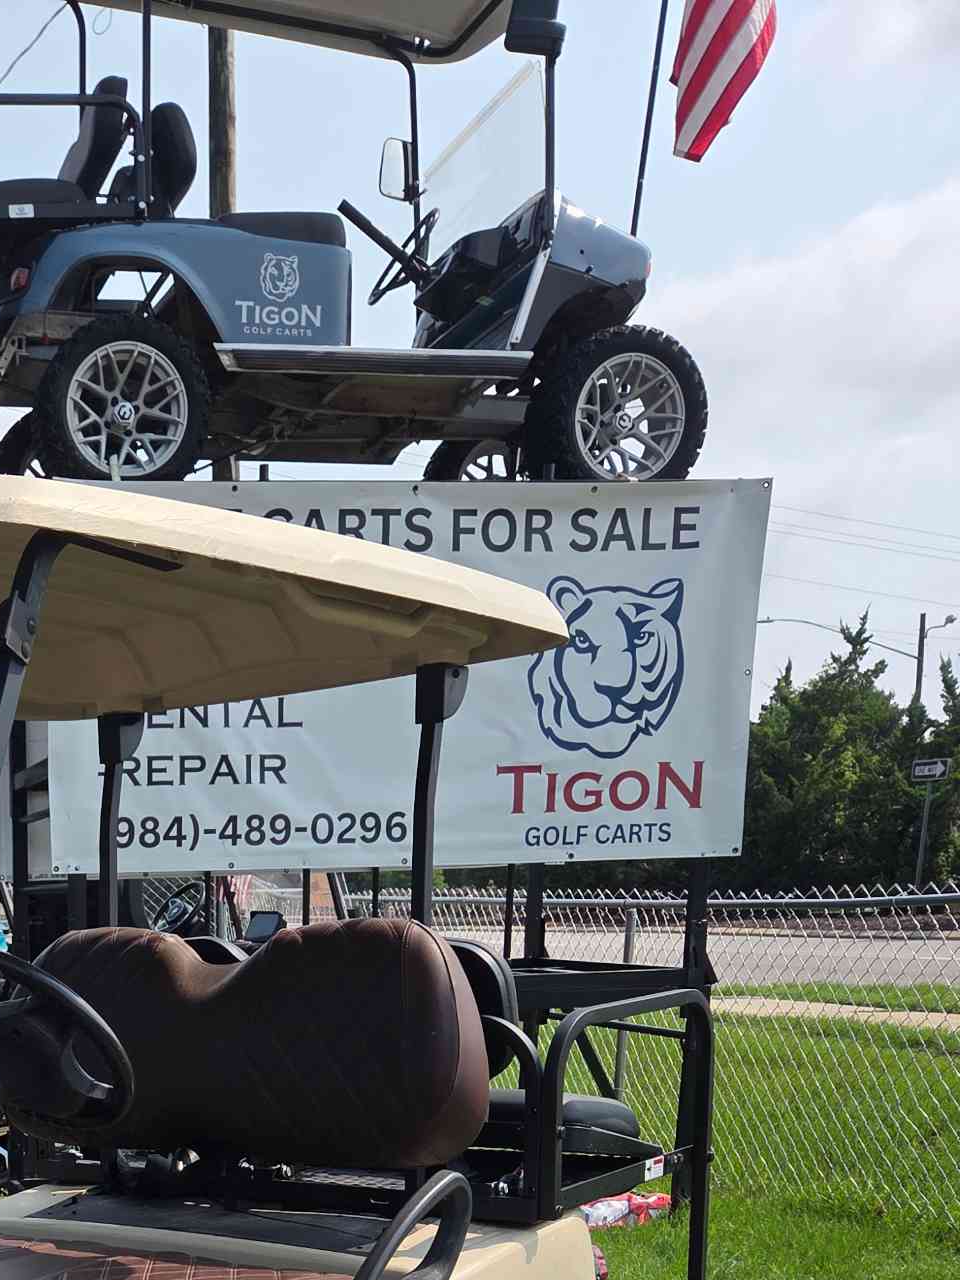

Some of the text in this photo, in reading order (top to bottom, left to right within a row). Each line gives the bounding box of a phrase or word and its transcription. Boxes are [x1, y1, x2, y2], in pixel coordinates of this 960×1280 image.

[234, 300, 322, 327] TIGON
[243, 325, 312, 337] GOLF CARTS
[451, 508, 554, 552] FOR
[568, 506, 700, 552] SALE
[146, 697, 304, 729] ENTAL
[496, 760, 705, 814] TIGON
[116, 812, 408, 850] 984)-489-0296
[524, 822, 672, 847] GOLF CARTS
